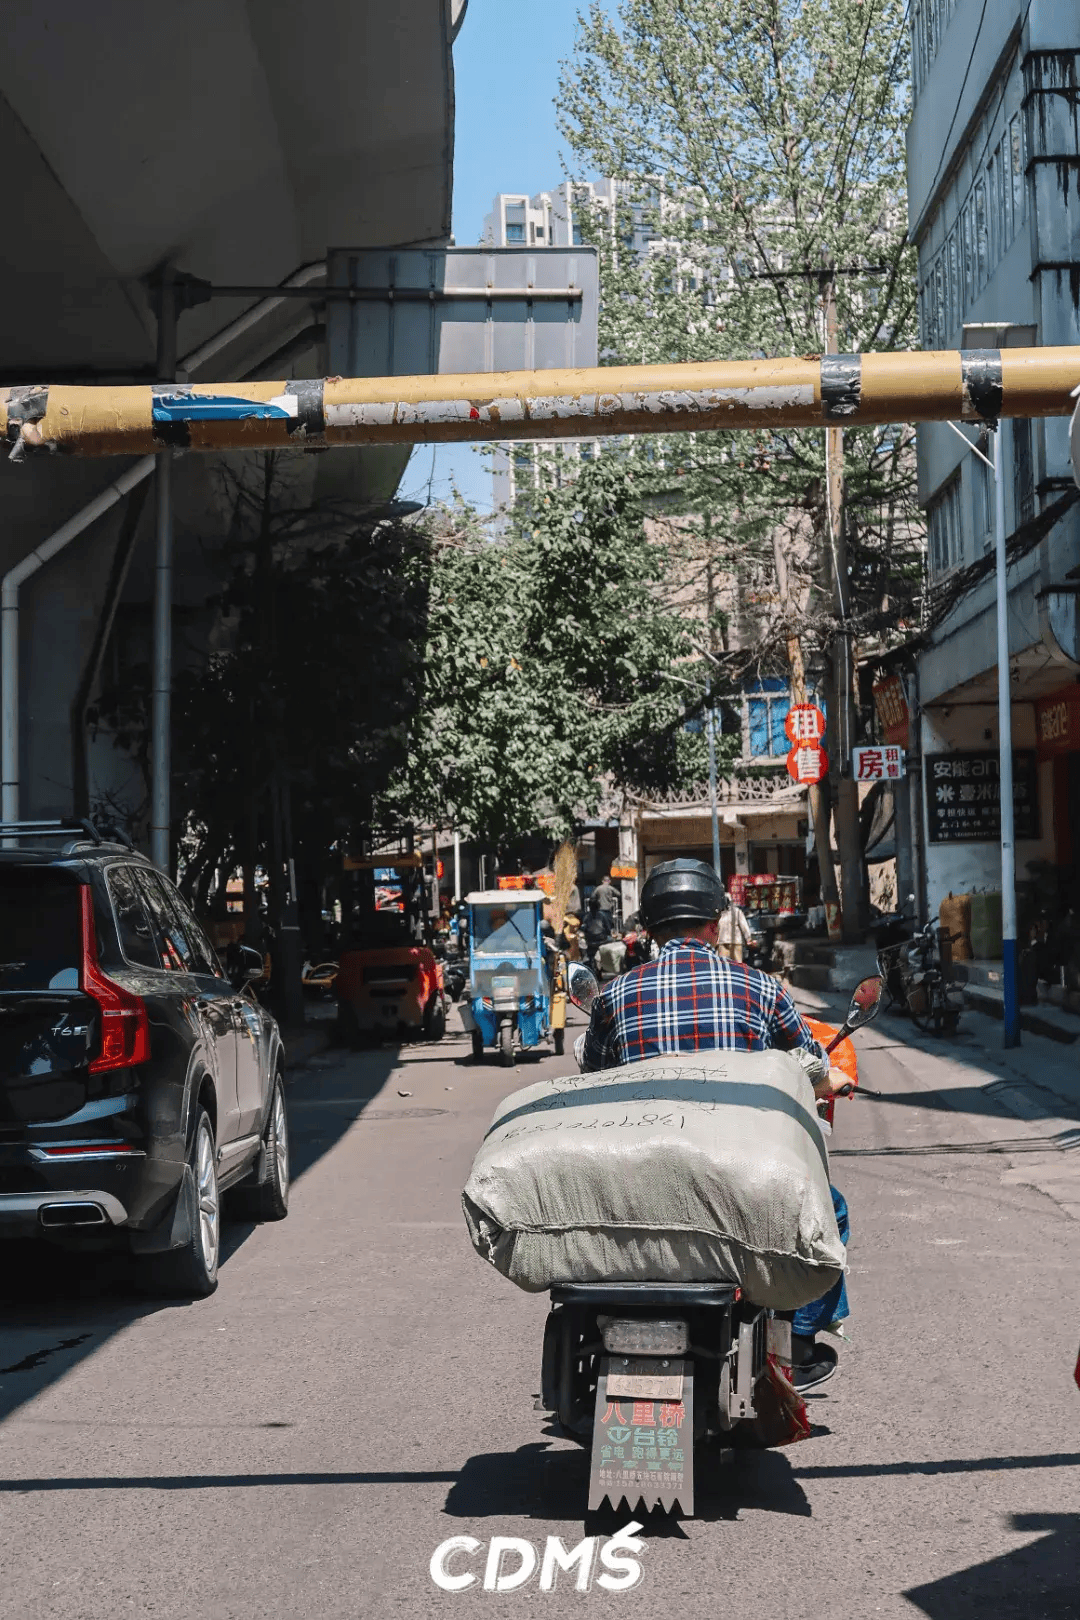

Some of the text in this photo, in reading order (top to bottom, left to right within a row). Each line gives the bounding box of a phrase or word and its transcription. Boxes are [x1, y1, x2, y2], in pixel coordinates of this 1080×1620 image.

[857, 749, 884, 778] 房
[600, 1402, 686, 1428] 八里桥
